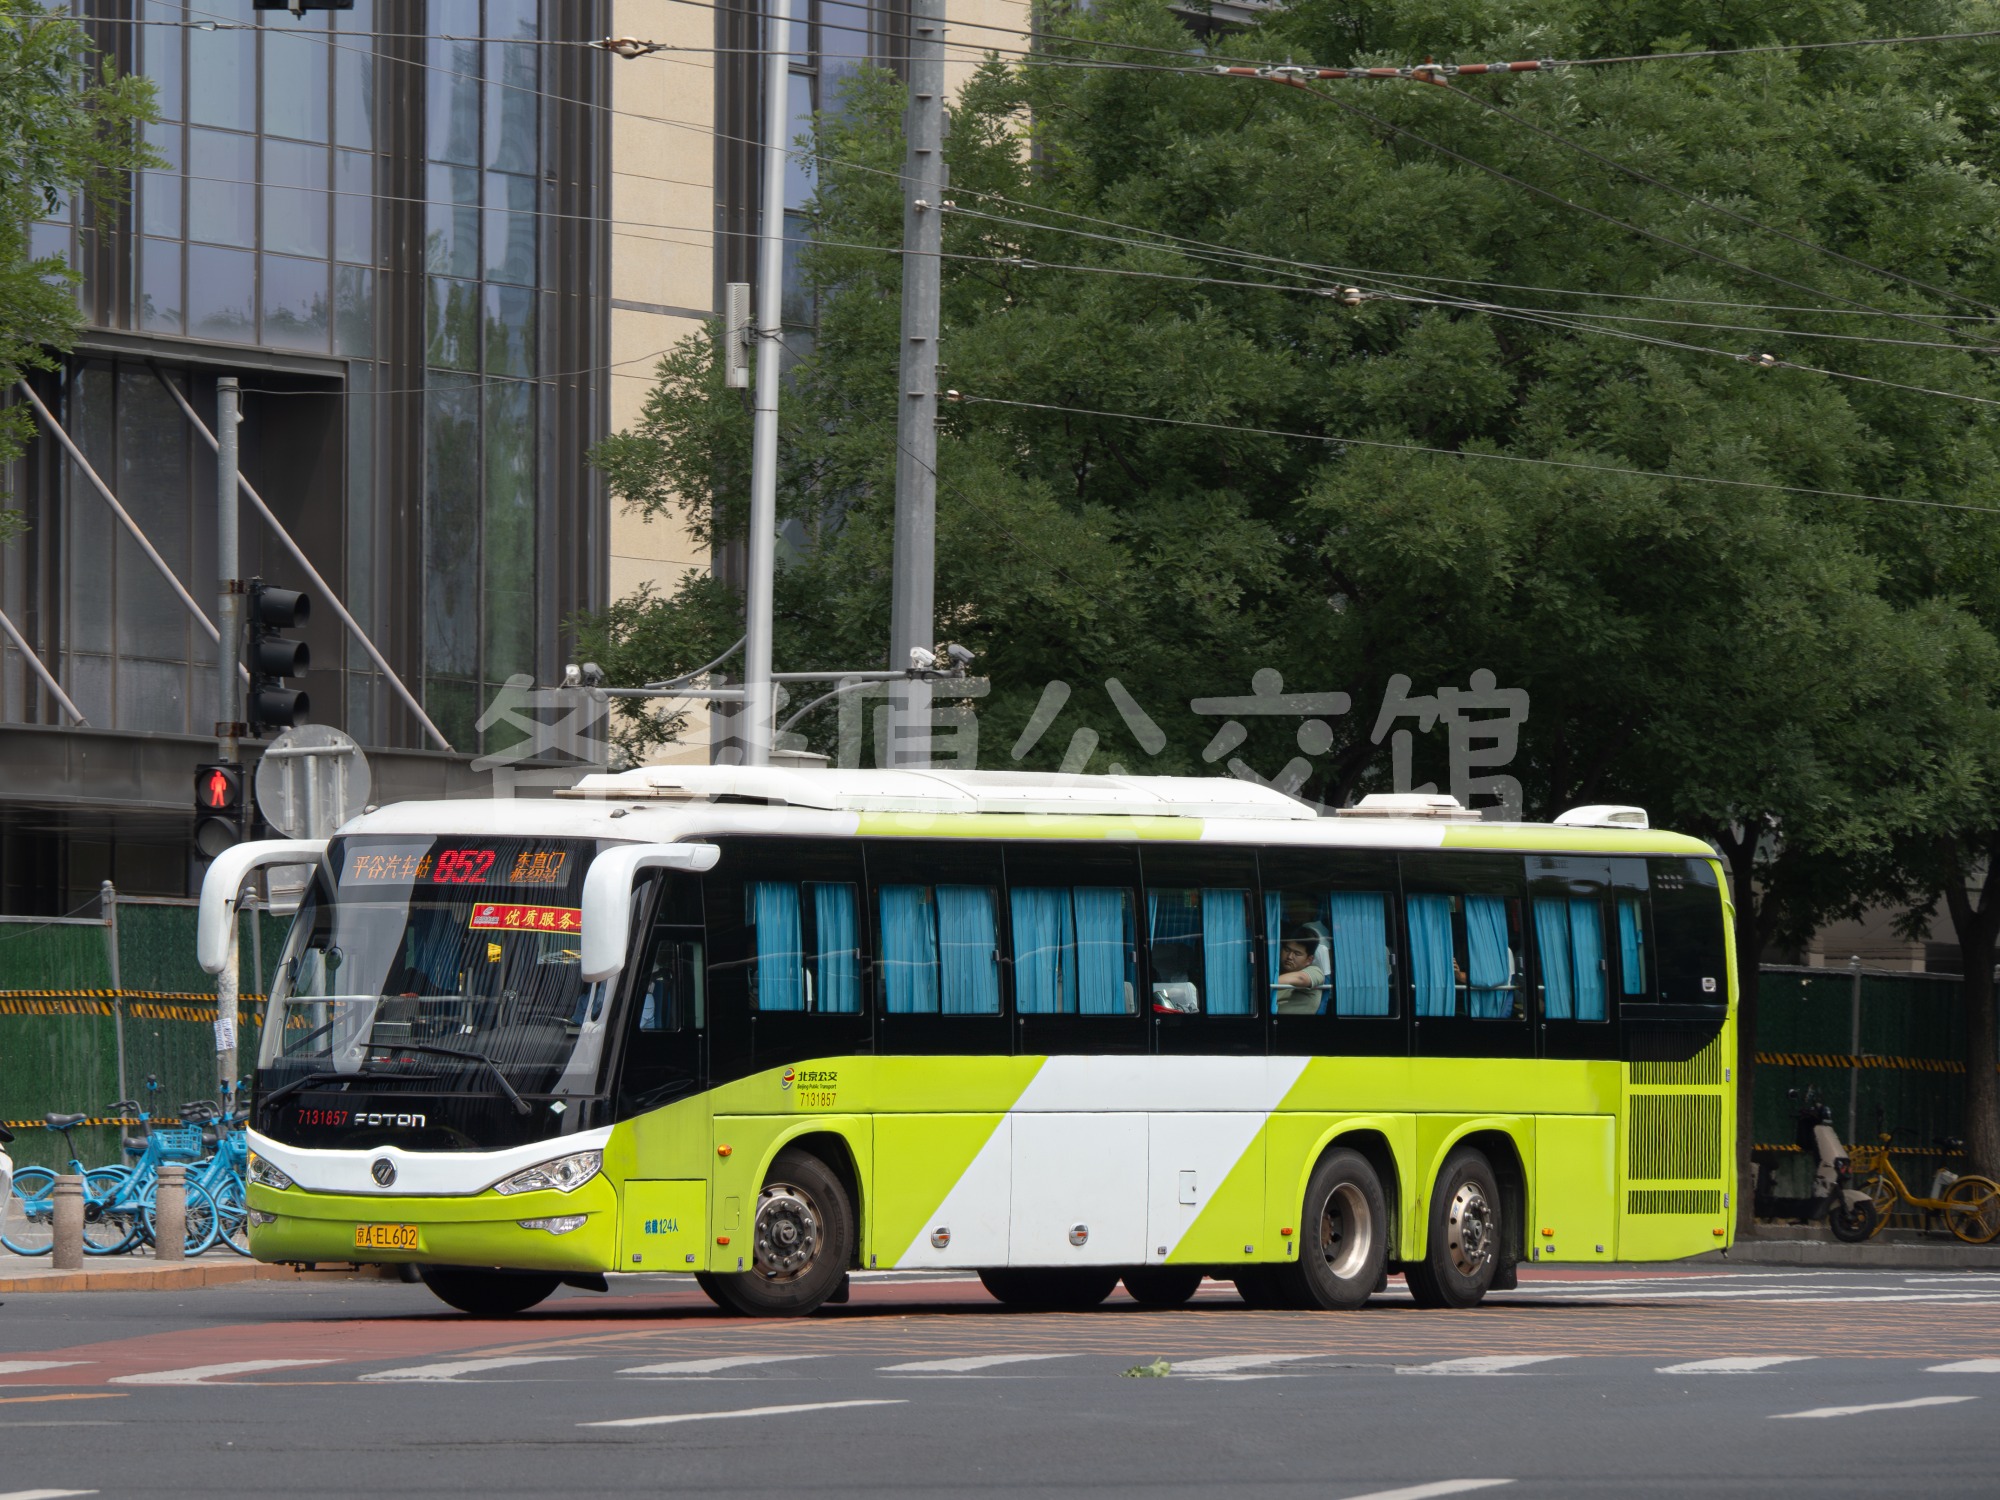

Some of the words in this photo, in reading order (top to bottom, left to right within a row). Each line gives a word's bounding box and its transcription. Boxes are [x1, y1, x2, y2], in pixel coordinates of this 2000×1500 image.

[352, 854, 433, 880] 平谷汽车站
[433, 850, 496, 883] 852
[514, 851, 567, 869] 东直门
[509, 867, 560, 883] 枢纽站
[504, 908, 582, 930] 优质服务
[798, 1071, 838, 1082] 北京公交
[800, 1092, 837, 1107] 7131857
[298, 1109, 348, 1126] 7131857
[354, 1113, 426, 1127] FOTON
